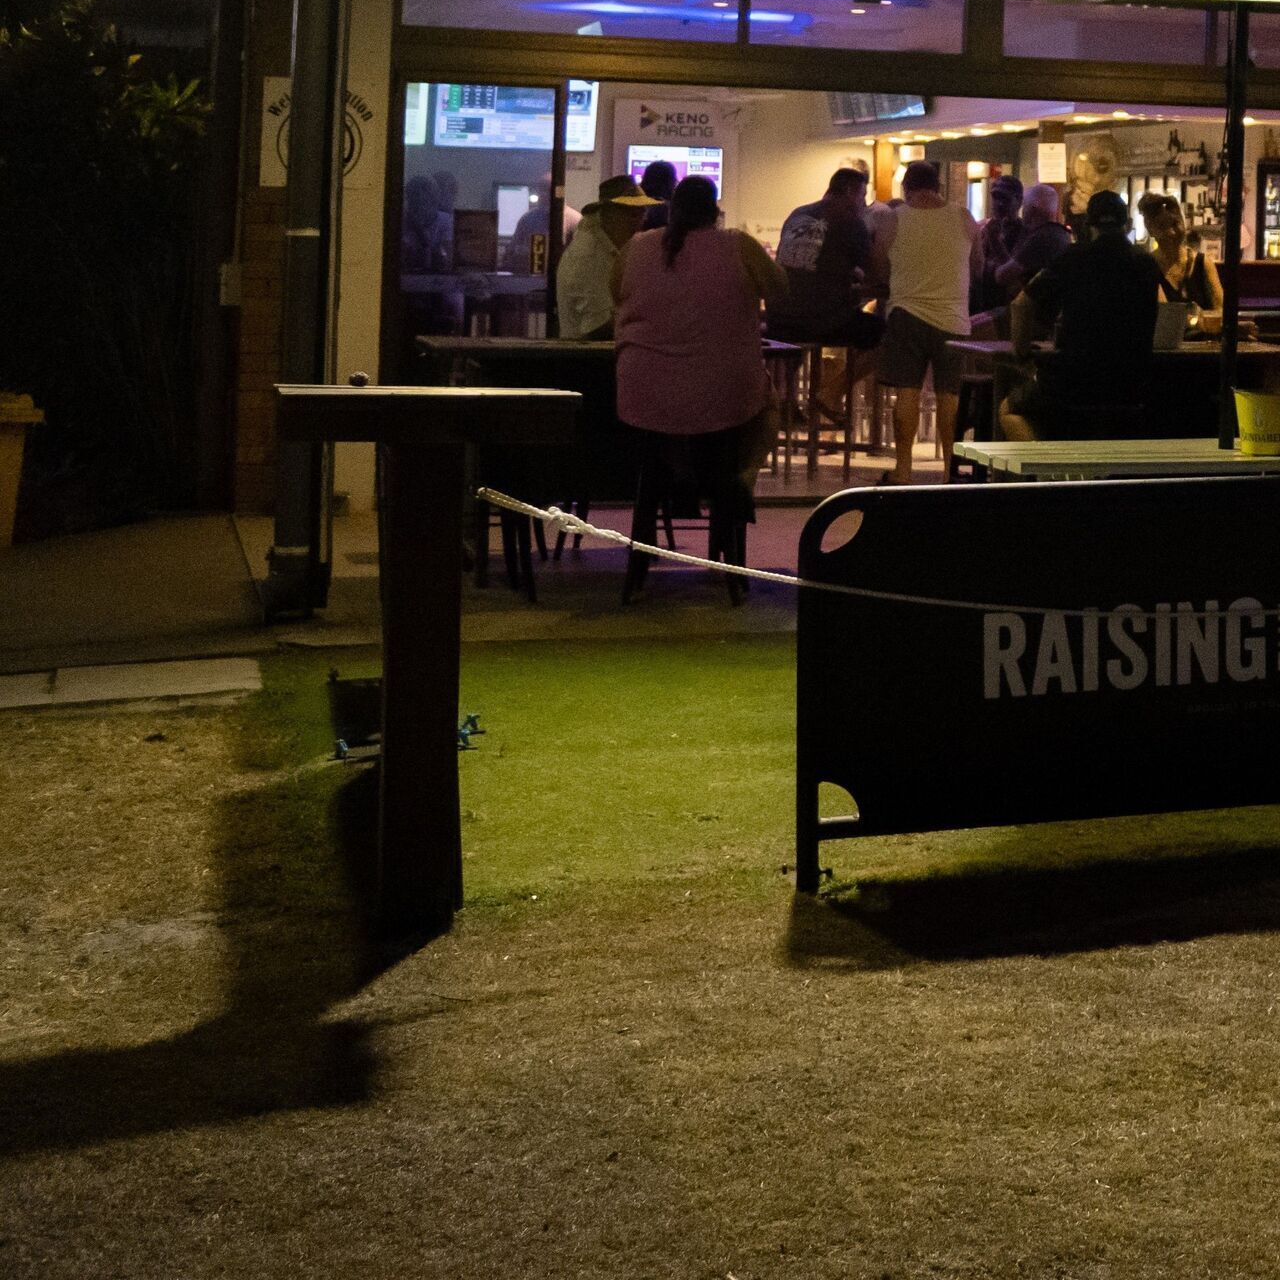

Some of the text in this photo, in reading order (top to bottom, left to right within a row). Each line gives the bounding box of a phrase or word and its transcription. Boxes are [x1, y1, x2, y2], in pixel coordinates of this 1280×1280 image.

[656, 125, 714, 137] RACING
[665, 113, 709, 124] KENO
[533, 235, 545, 273] PULL
[982, 596, 1267, 699] RAISING
